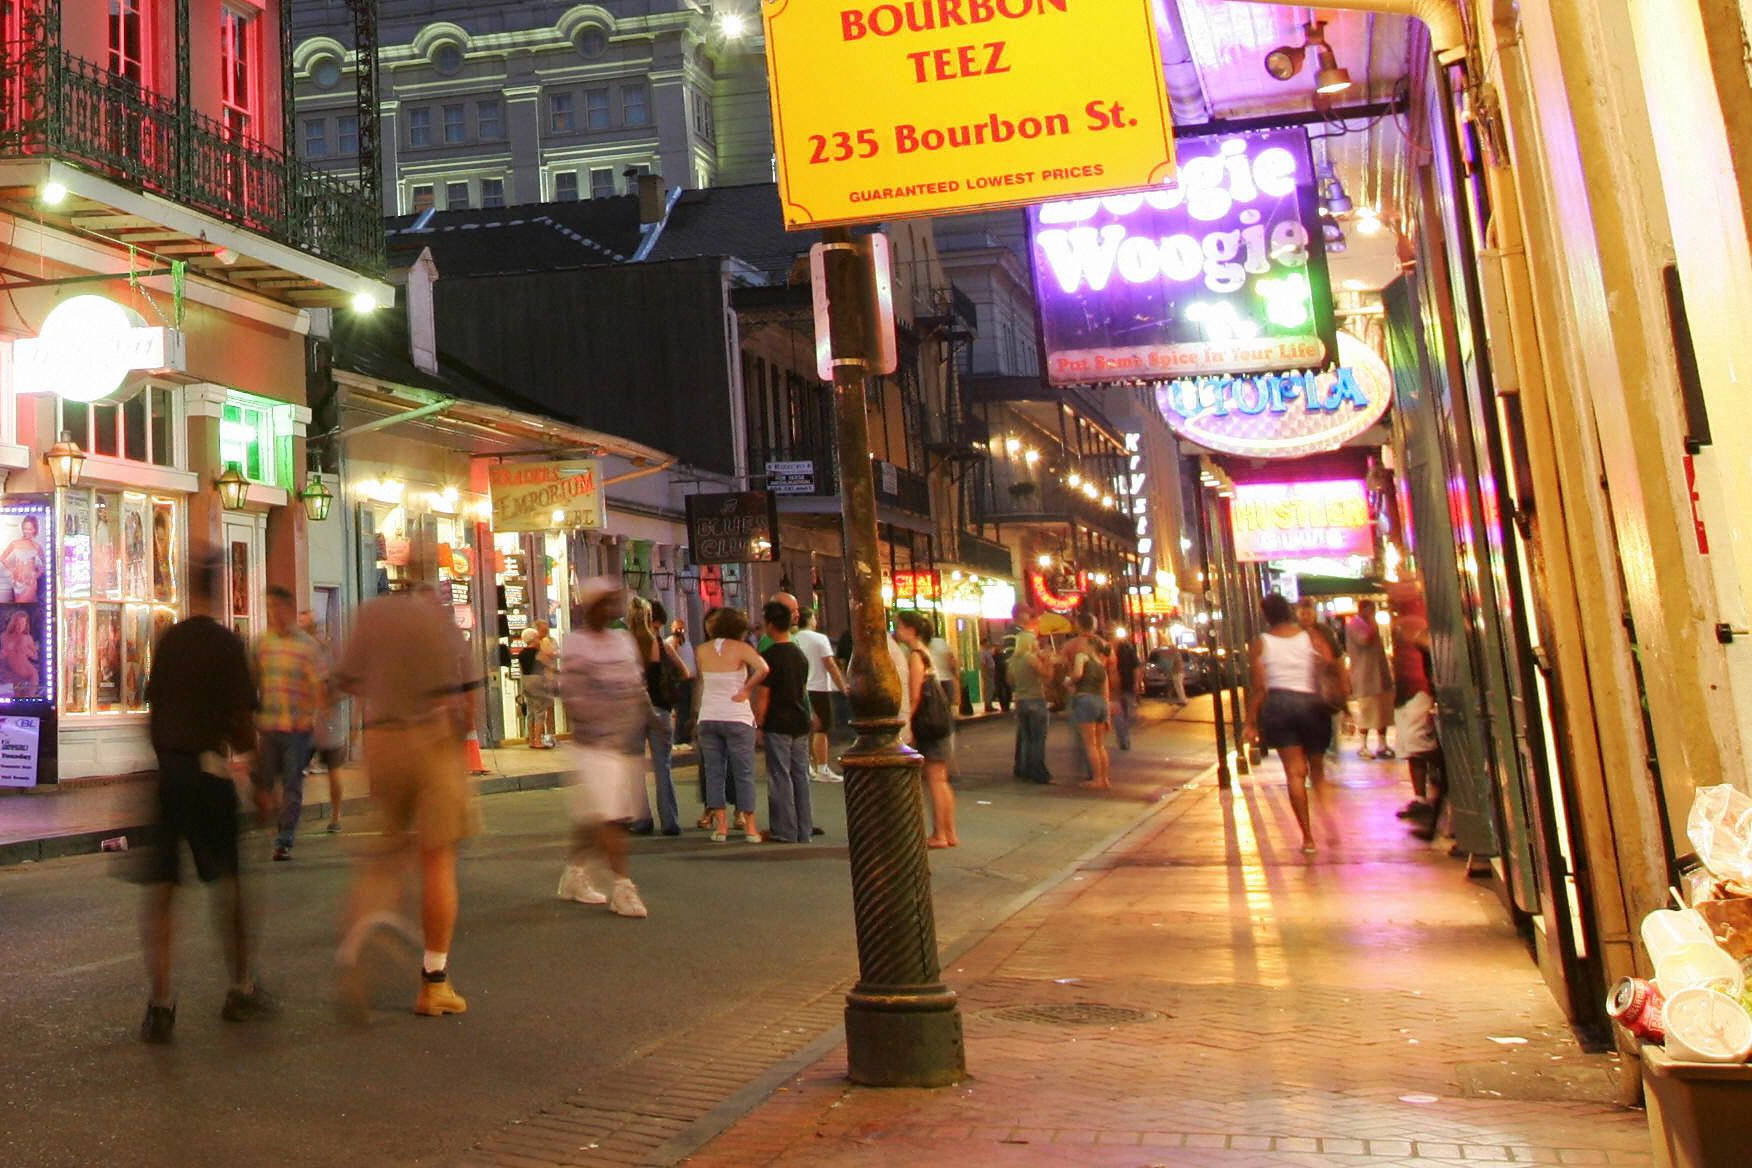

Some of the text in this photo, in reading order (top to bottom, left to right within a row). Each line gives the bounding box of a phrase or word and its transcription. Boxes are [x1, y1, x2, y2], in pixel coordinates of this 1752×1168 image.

[907, 41, 1011, 84] TEEZ
[808, 99, 1138, 165] 235 Bourbon St.
[849, 163, 1105, 203] GUARANTEED LOWEST PRICES
[1037, 209, 1309, 294] Woogie
[1148, 350, 1197, 370] Spice
[1279, 343, 1317, 361] Life
[1168, 367, 1369, 419] UTOPIA
[1234, 496, 1367, 533] HUSTLER
